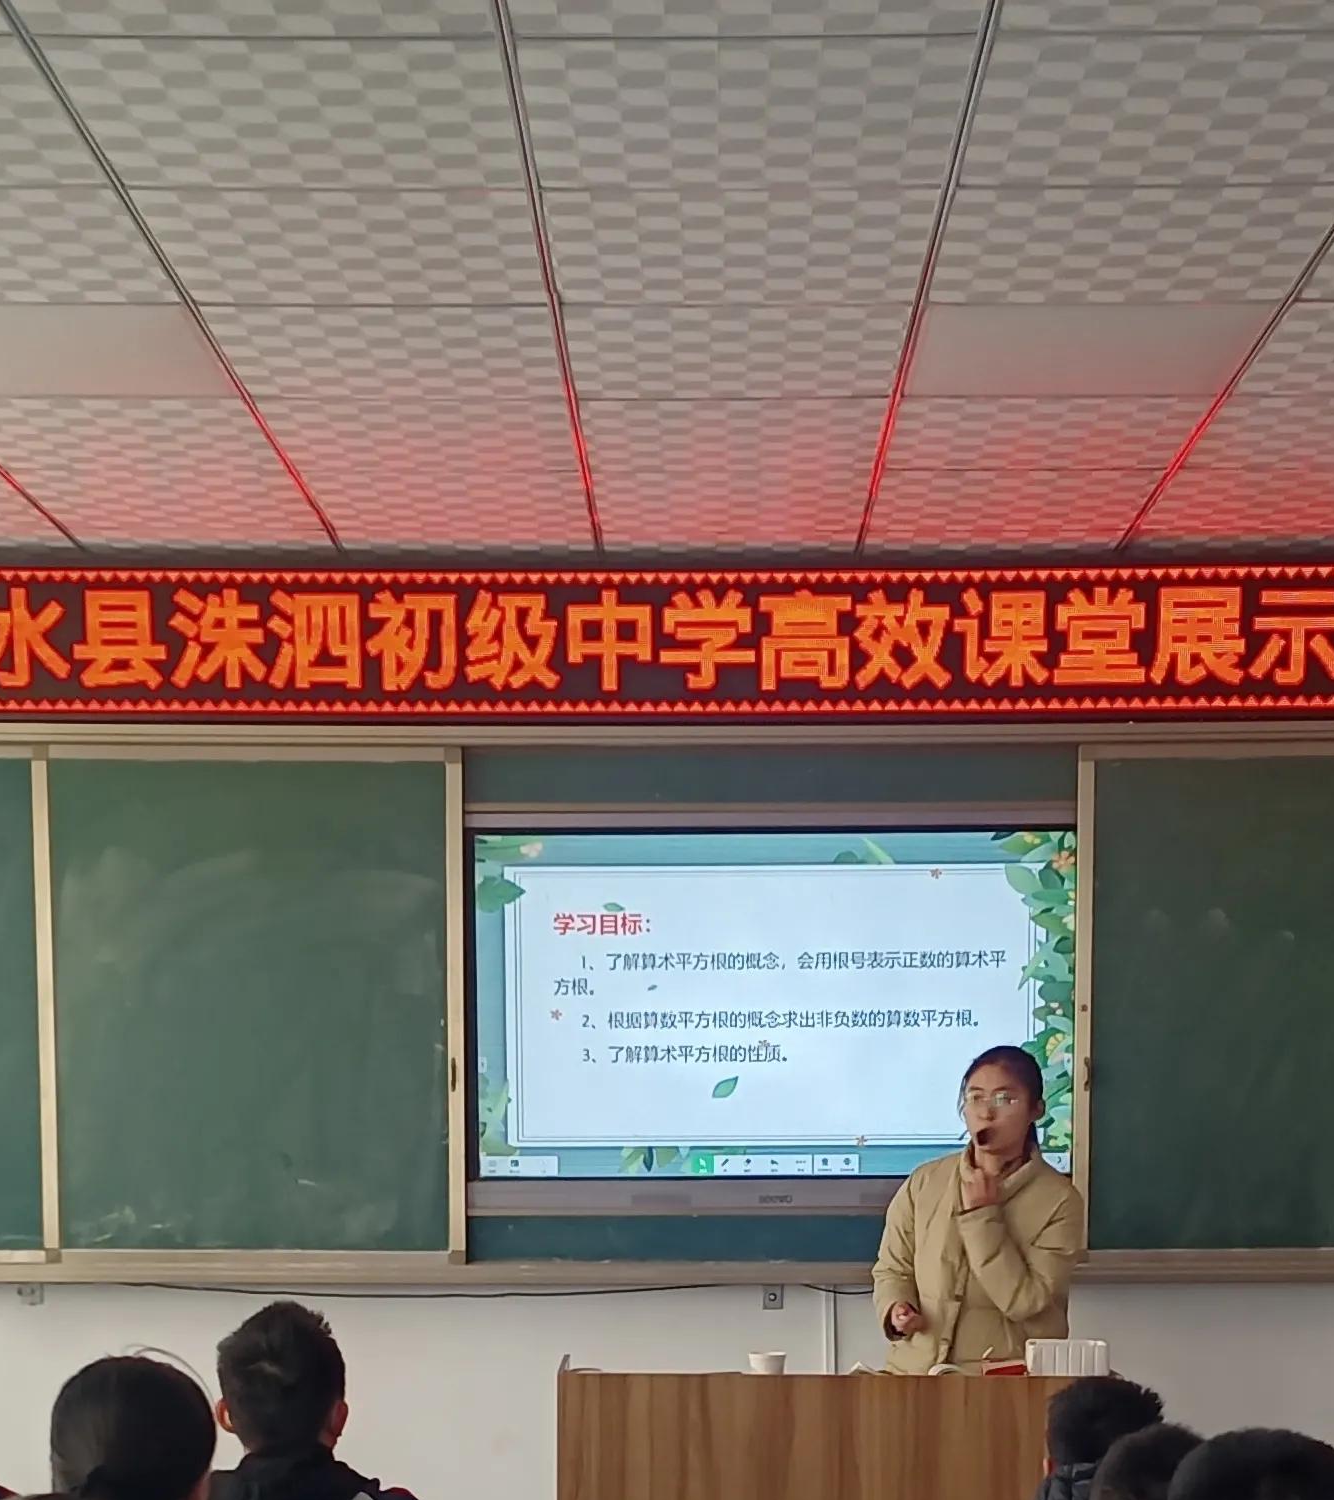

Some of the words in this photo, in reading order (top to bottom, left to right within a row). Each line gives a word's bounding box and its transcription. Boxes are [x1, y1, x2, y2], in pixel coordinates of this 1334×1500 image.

[553, 913, 651, 936] 学习目标：
[553, 977, 595, 996] 方根。
